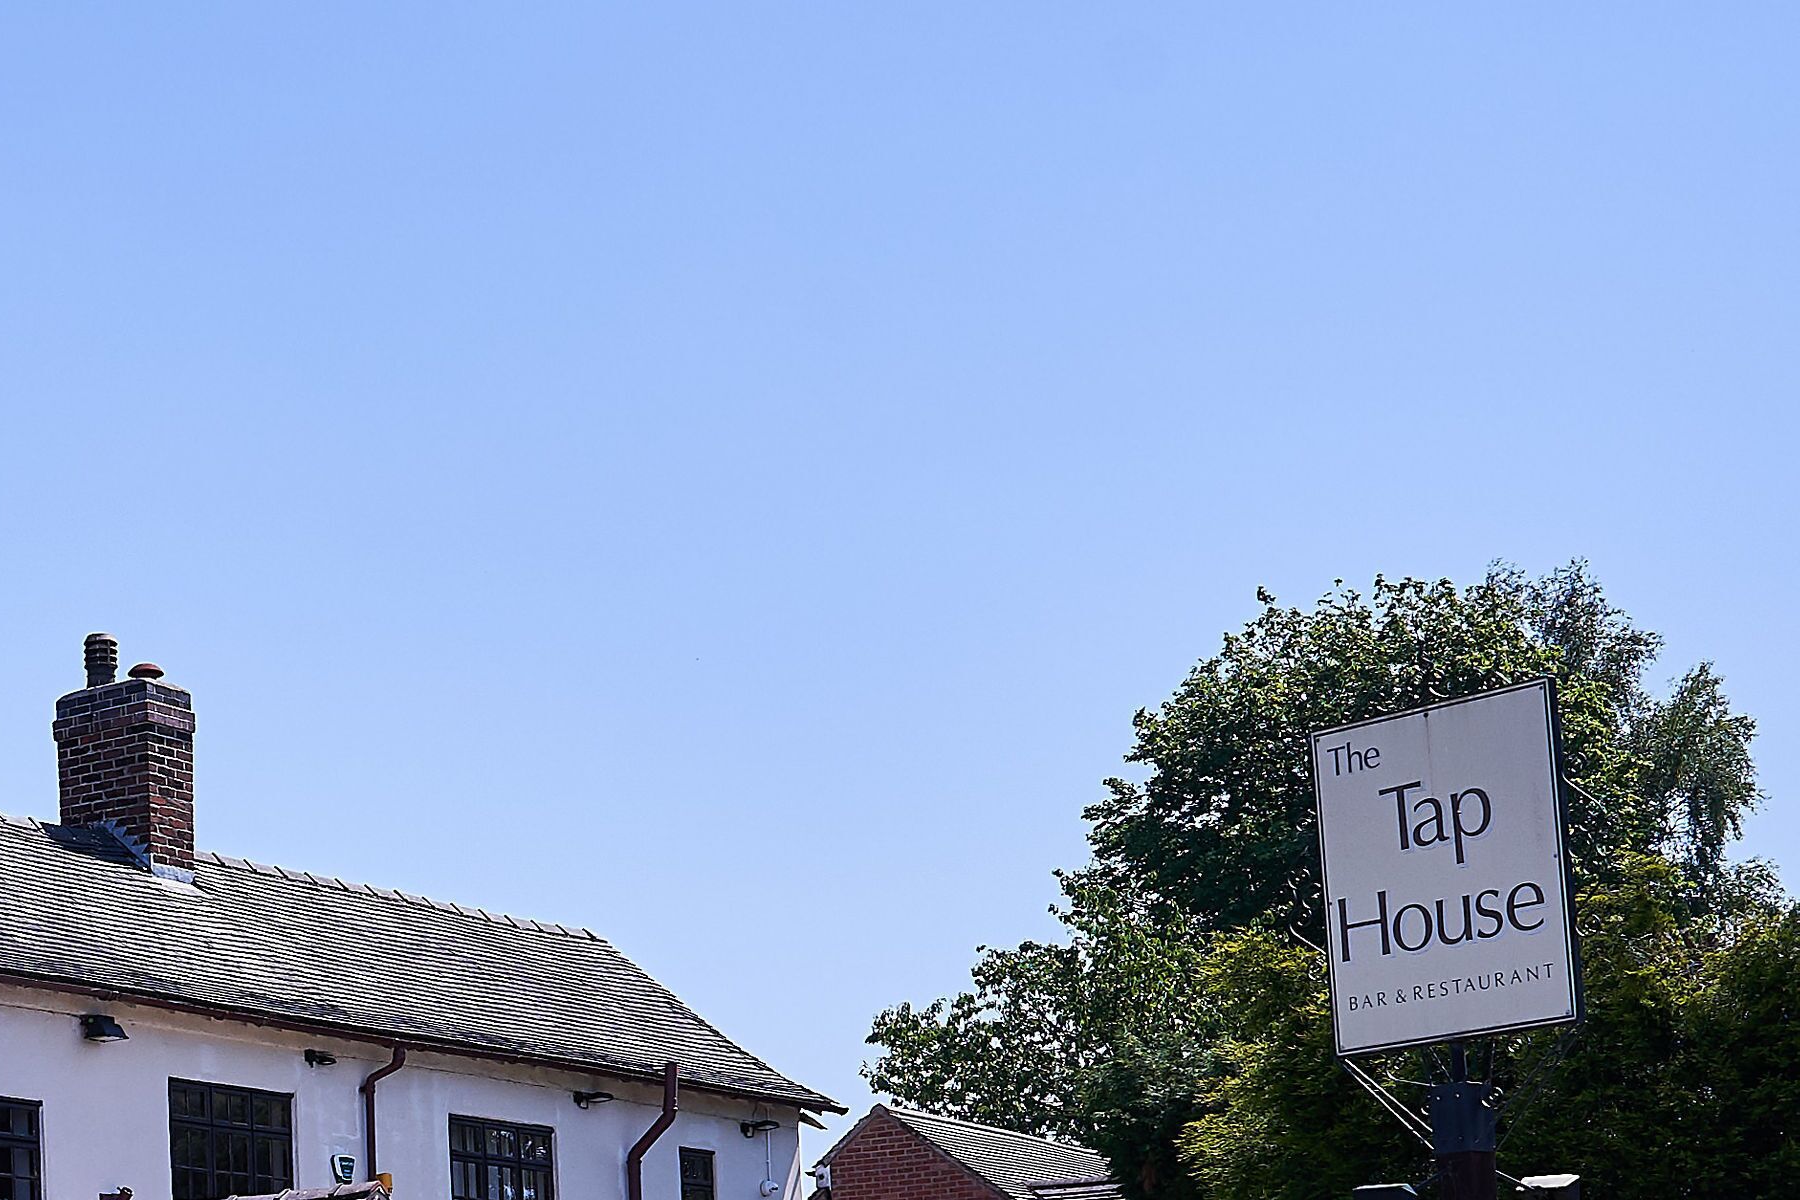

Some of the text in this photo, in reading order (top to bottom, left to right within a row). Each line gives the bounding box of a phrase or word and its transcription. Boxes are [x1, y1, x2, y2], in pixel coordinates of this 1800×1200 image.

[1327, 742, 1381, 776] The
[1379, 780, 1491, 864] Tap
[1338, 880, 1546, 963] House
[1349, 962, 1555, 1011] BAR & RESTAURANT
